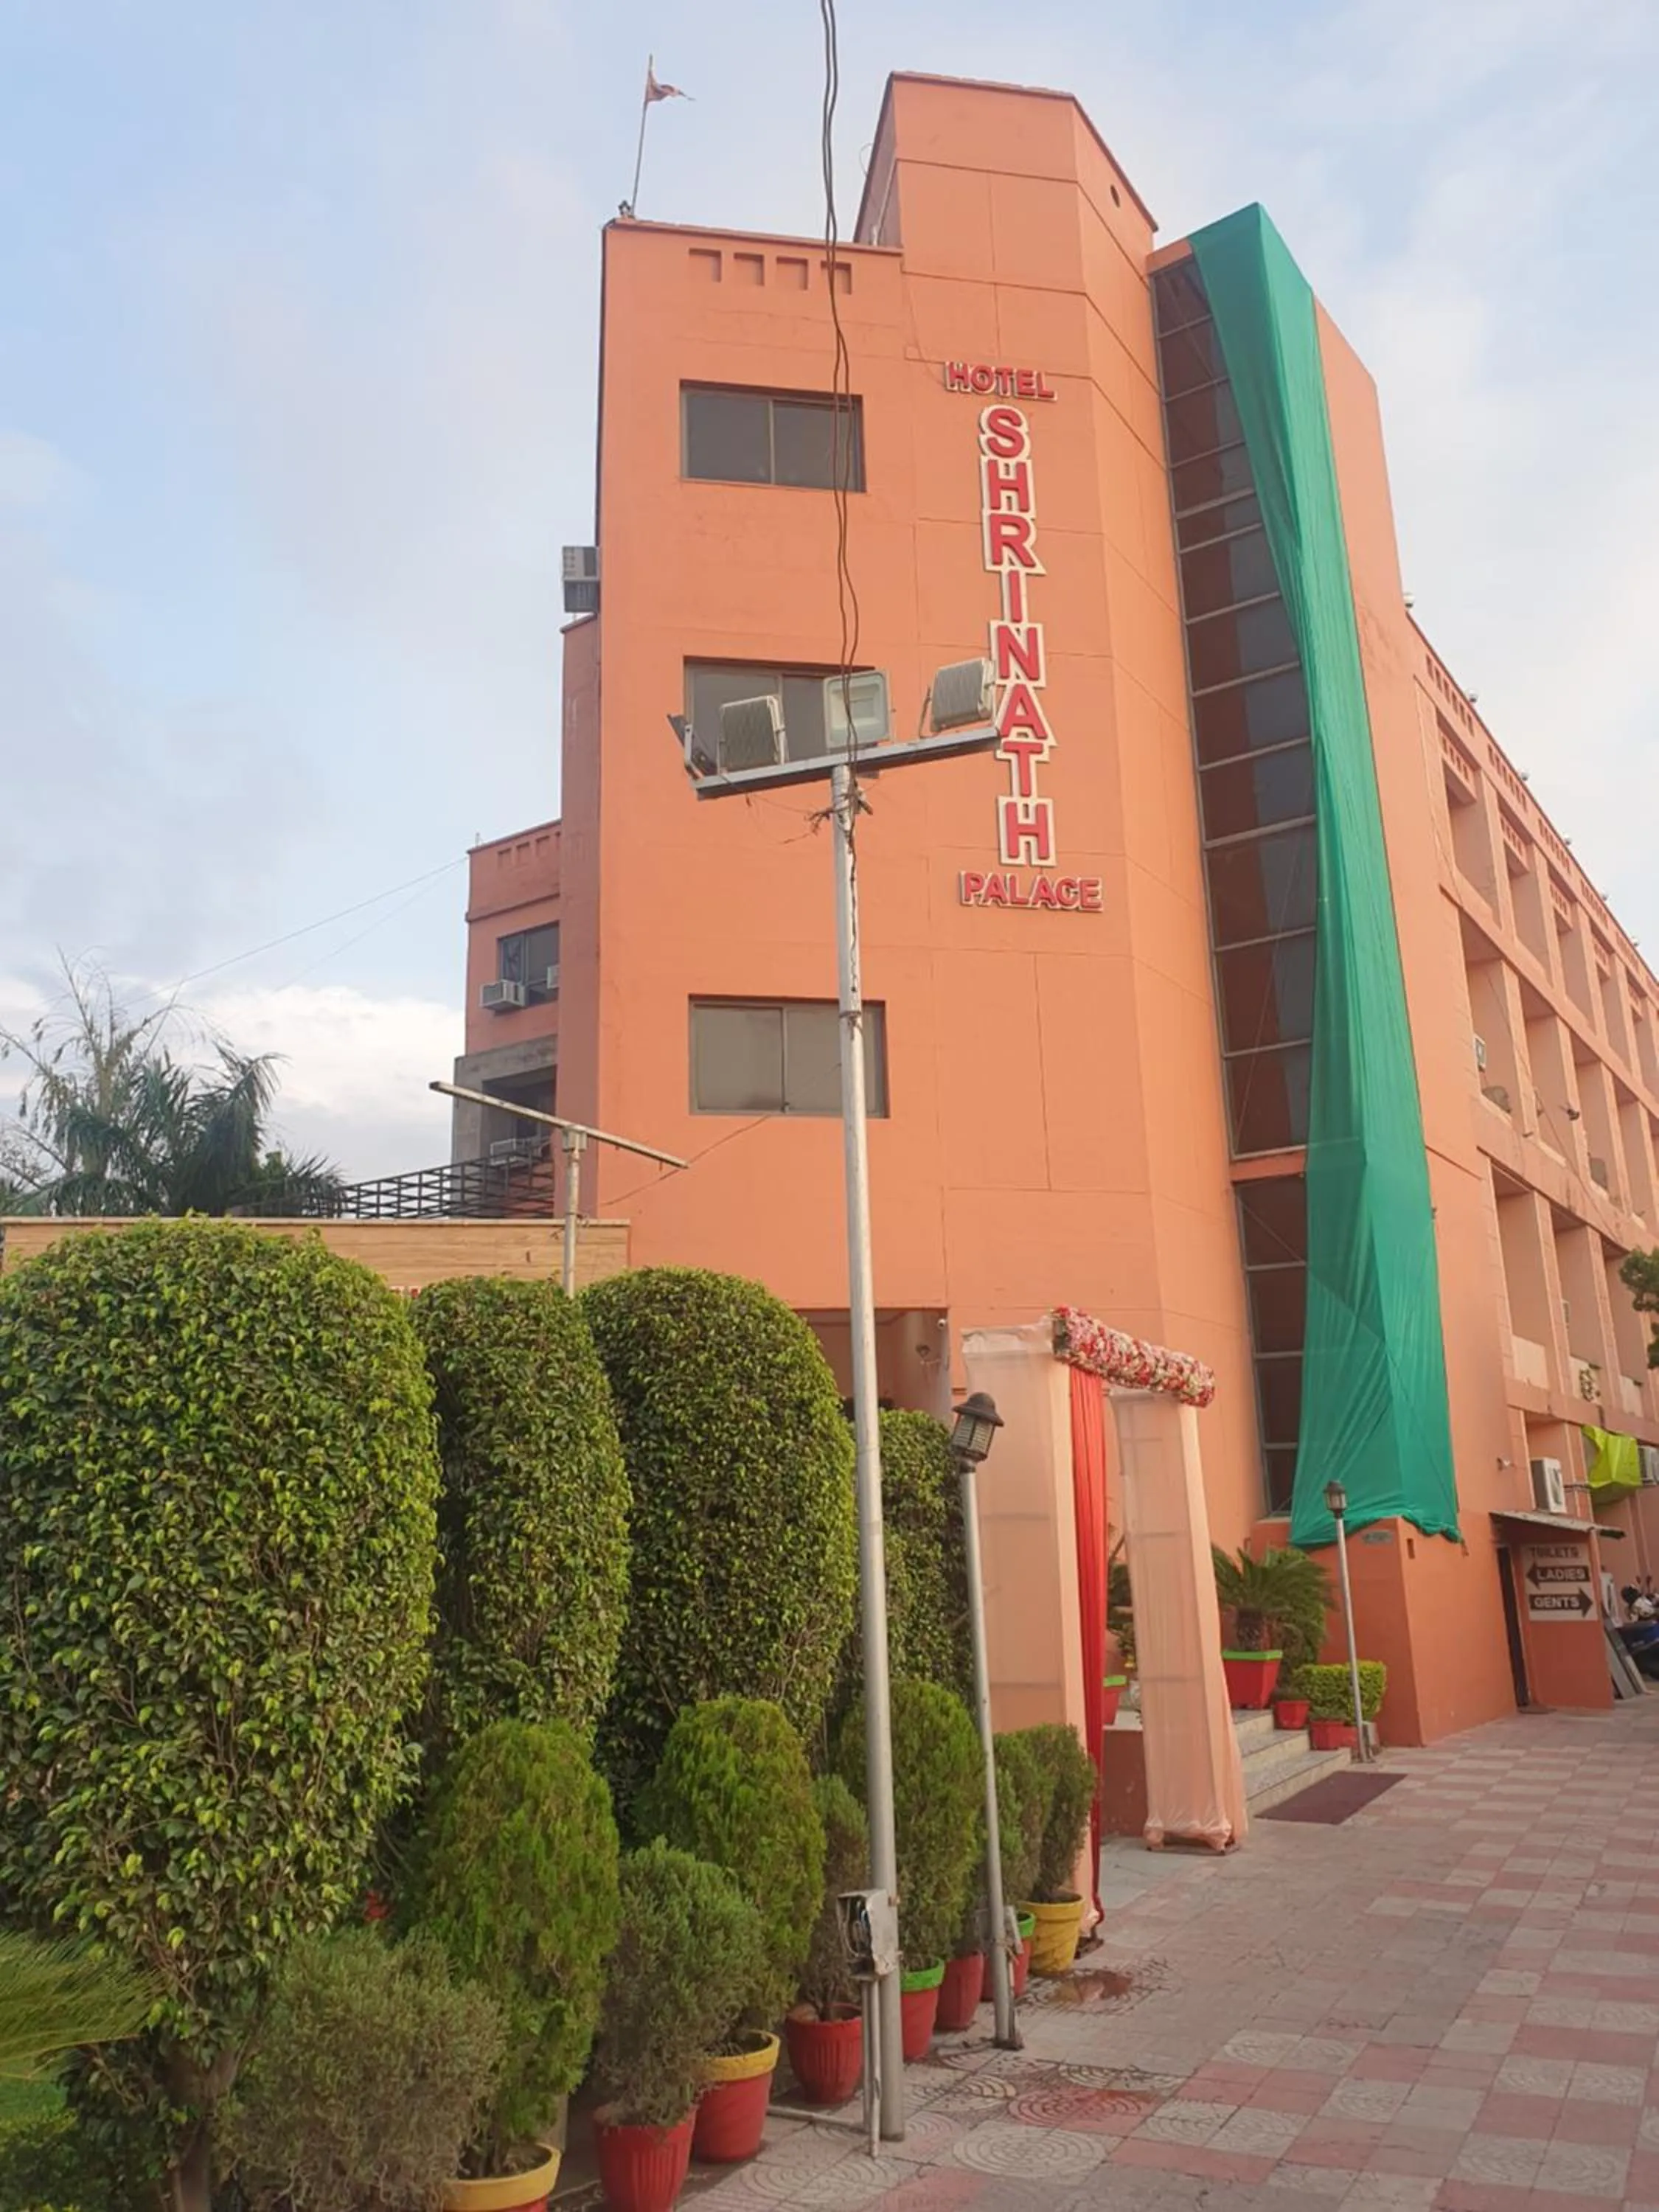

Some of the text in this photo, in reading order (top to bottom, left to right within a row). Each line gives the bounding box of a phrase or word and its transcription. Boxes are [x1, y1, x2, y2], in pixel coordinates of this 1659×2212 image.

[946, 361, 1057, 400] HOTEL
[981, 405, 1056, 866] SHRINATH
[961, 871, 1103, 912] PALACE
[1536, 1568, 1586, 1581] LADIES
[1534, 1596, 1580, 1608] GENTS
